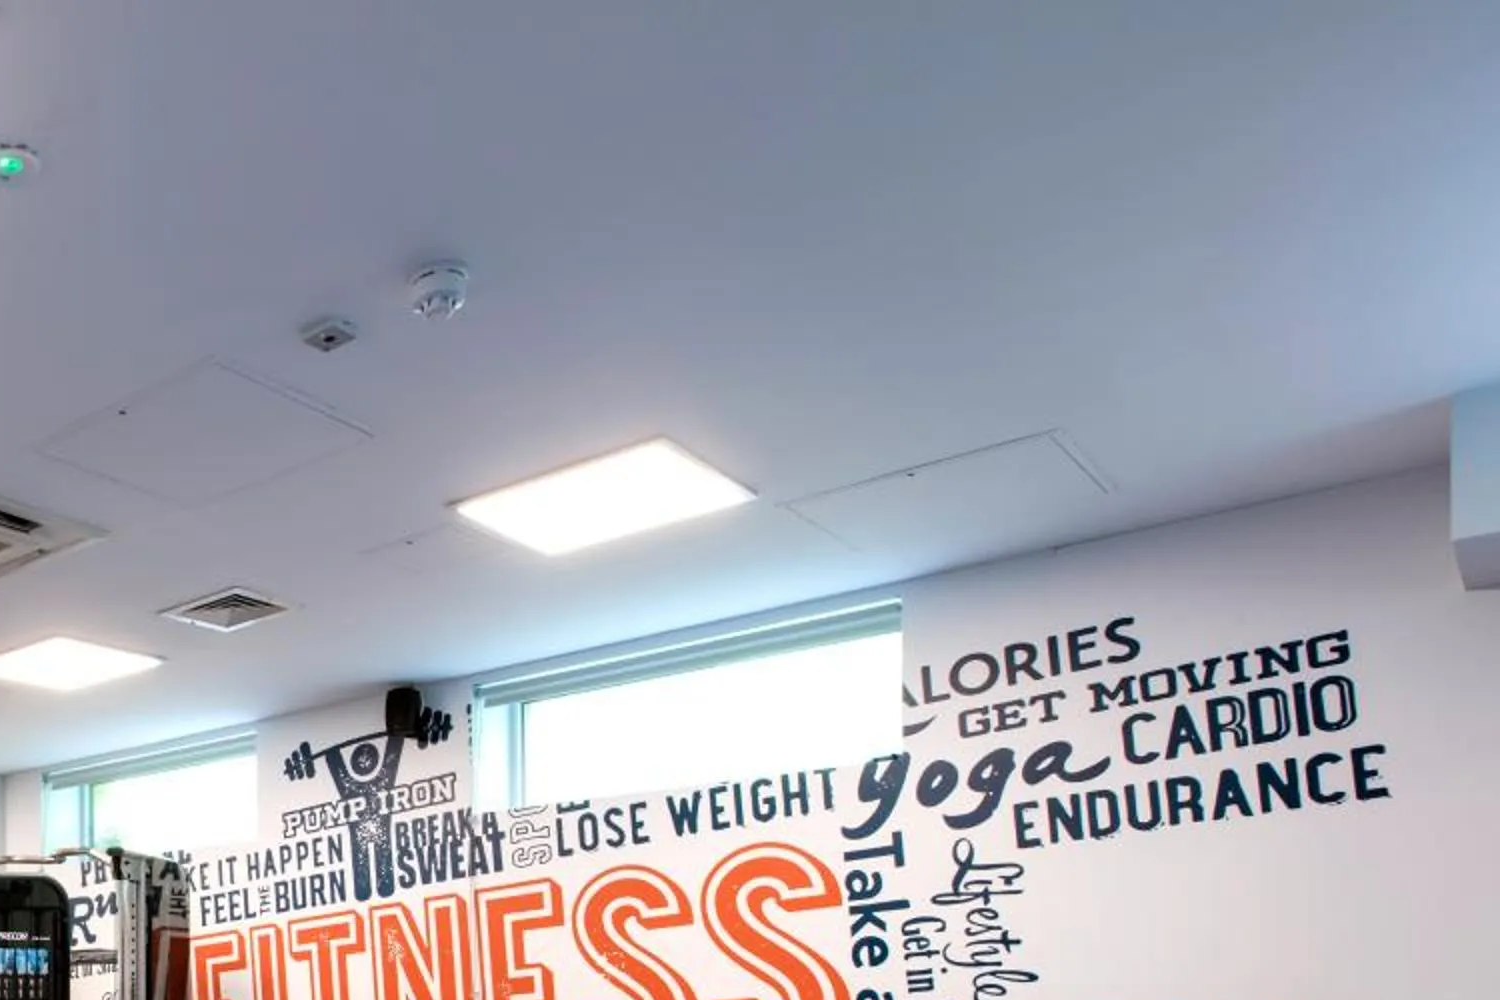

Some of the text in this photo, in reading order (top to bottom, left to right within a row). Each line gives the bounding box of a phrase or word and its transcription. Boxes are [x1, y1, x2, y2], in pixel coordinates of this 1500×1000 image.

[902, 616, 1141, 706] LORIES
[958, 630, 1350, 738] GET MOVING
[841, 675, 1358, 840] yoga CARDIO
[282, 772, 456, 838] PUMP IRON
[395, 806, 474, 850] BREAK
[556, 768, 836, 857] LOSE WEIGHT
[1013, 745, 1392, 849] ENDURANCE
[218, 855, 238, 887] IT
[246, 834, 344, 882] HAPPEN
[397, 829, 506, 888] SWEAT
[200, 868, 348, 927] FEEL THE BURN
[843, 831, 911, 968] Take
[901, 915, 947, 960] Get
[906, 967, 948, 993] in
